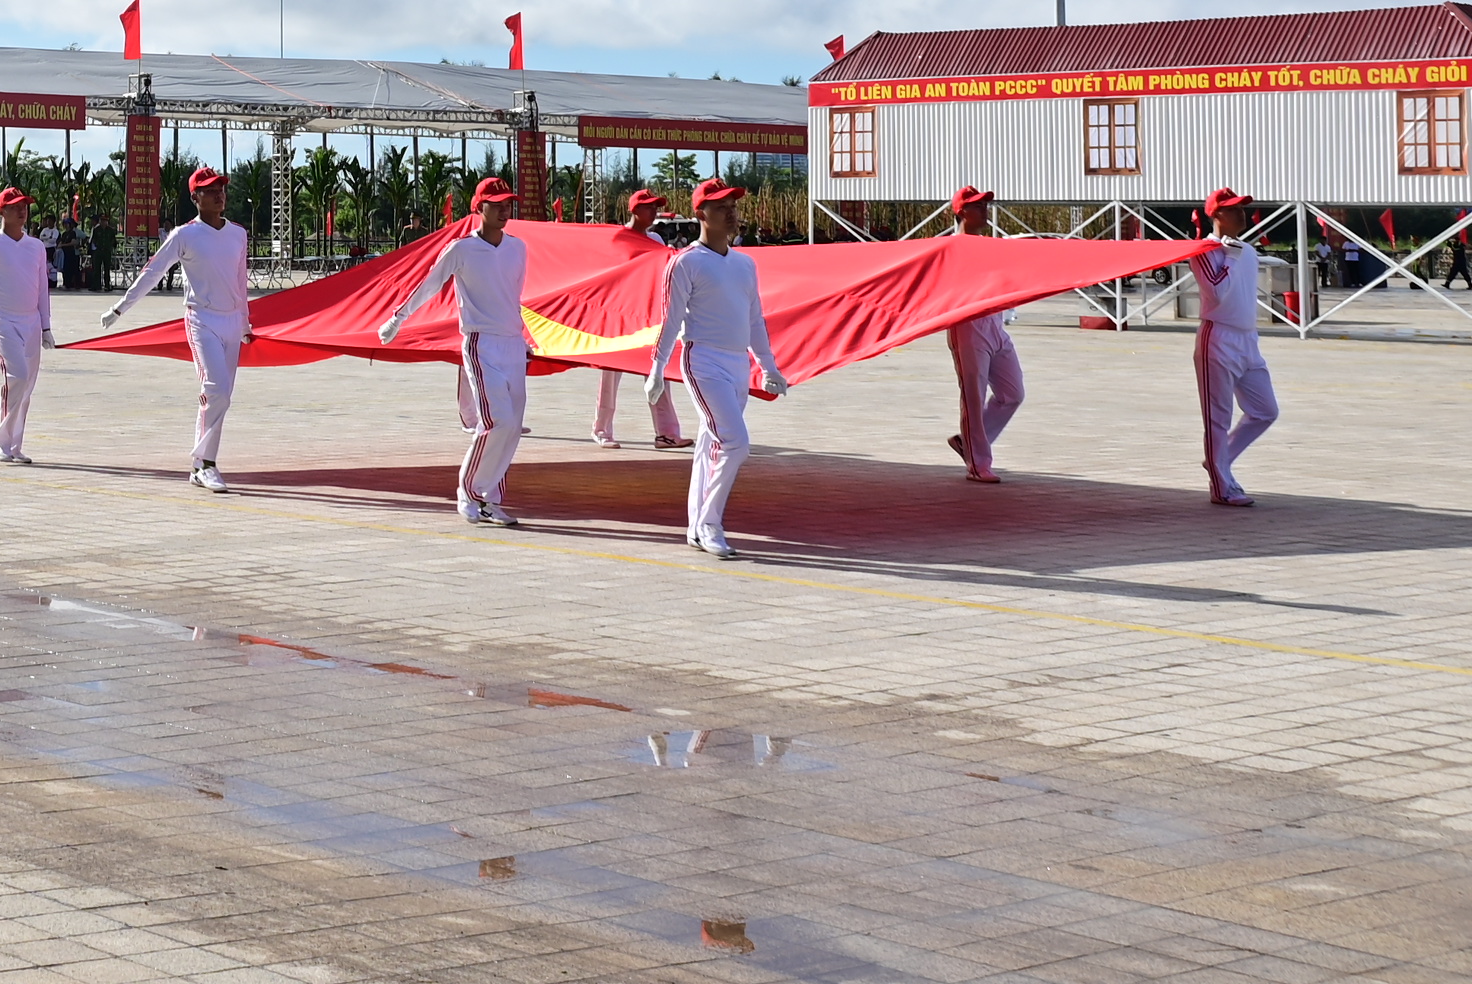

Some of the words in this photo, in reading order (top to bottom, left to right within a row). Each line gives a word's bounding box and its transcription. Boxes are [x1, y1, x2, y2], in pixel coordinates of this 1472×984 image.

[831, 82, 857, 101] "TỔ
[860, 82, 892, 100] LIÊN
[896, 83, 921, 98] GIA
[925, 82, 947, 98] AN
[950, 78, 991, 96] TOÀN
[995, 79, 1046, 96] PCCC"
[1051, 73, 1102, 94] QUYẾT
[1107, 73, 1144, 92] TÂM
[1148, 70, 1210, 90] PHÒNG
[1214, 69, 1262, 88] CHÁY
[1267, 66, 1304, 88] TỐT,
[1309, 66, 1362, 85] CHỮA
[1366, 63, 1420, 84] CHÁY
[1426, 60, 1467, 82] GIỎI
[18, 102, 46, 120] CHỮA
[50, 103, 77, 121] CHÁY
[596, 124, 615, 138] NGƯỜI
[616, 125, 628, 140] DÂN
[643, 126, 651, 140] CÓ
[652, 126, 666, 141] KIẾN
[667, 128, 682, 142] THỨC
[682, 128, 702, 142] PHÒNG
[704, 129, 719, 143] CHÁY,
[720, 130, 736, 144] CHỮA
[736, 130, 751, 144] CHÁY
[760, 132, 768, 147] TỰ
[781, 132, 788, 148] VỆ
[789, 132, 804, 147] MÌNH
